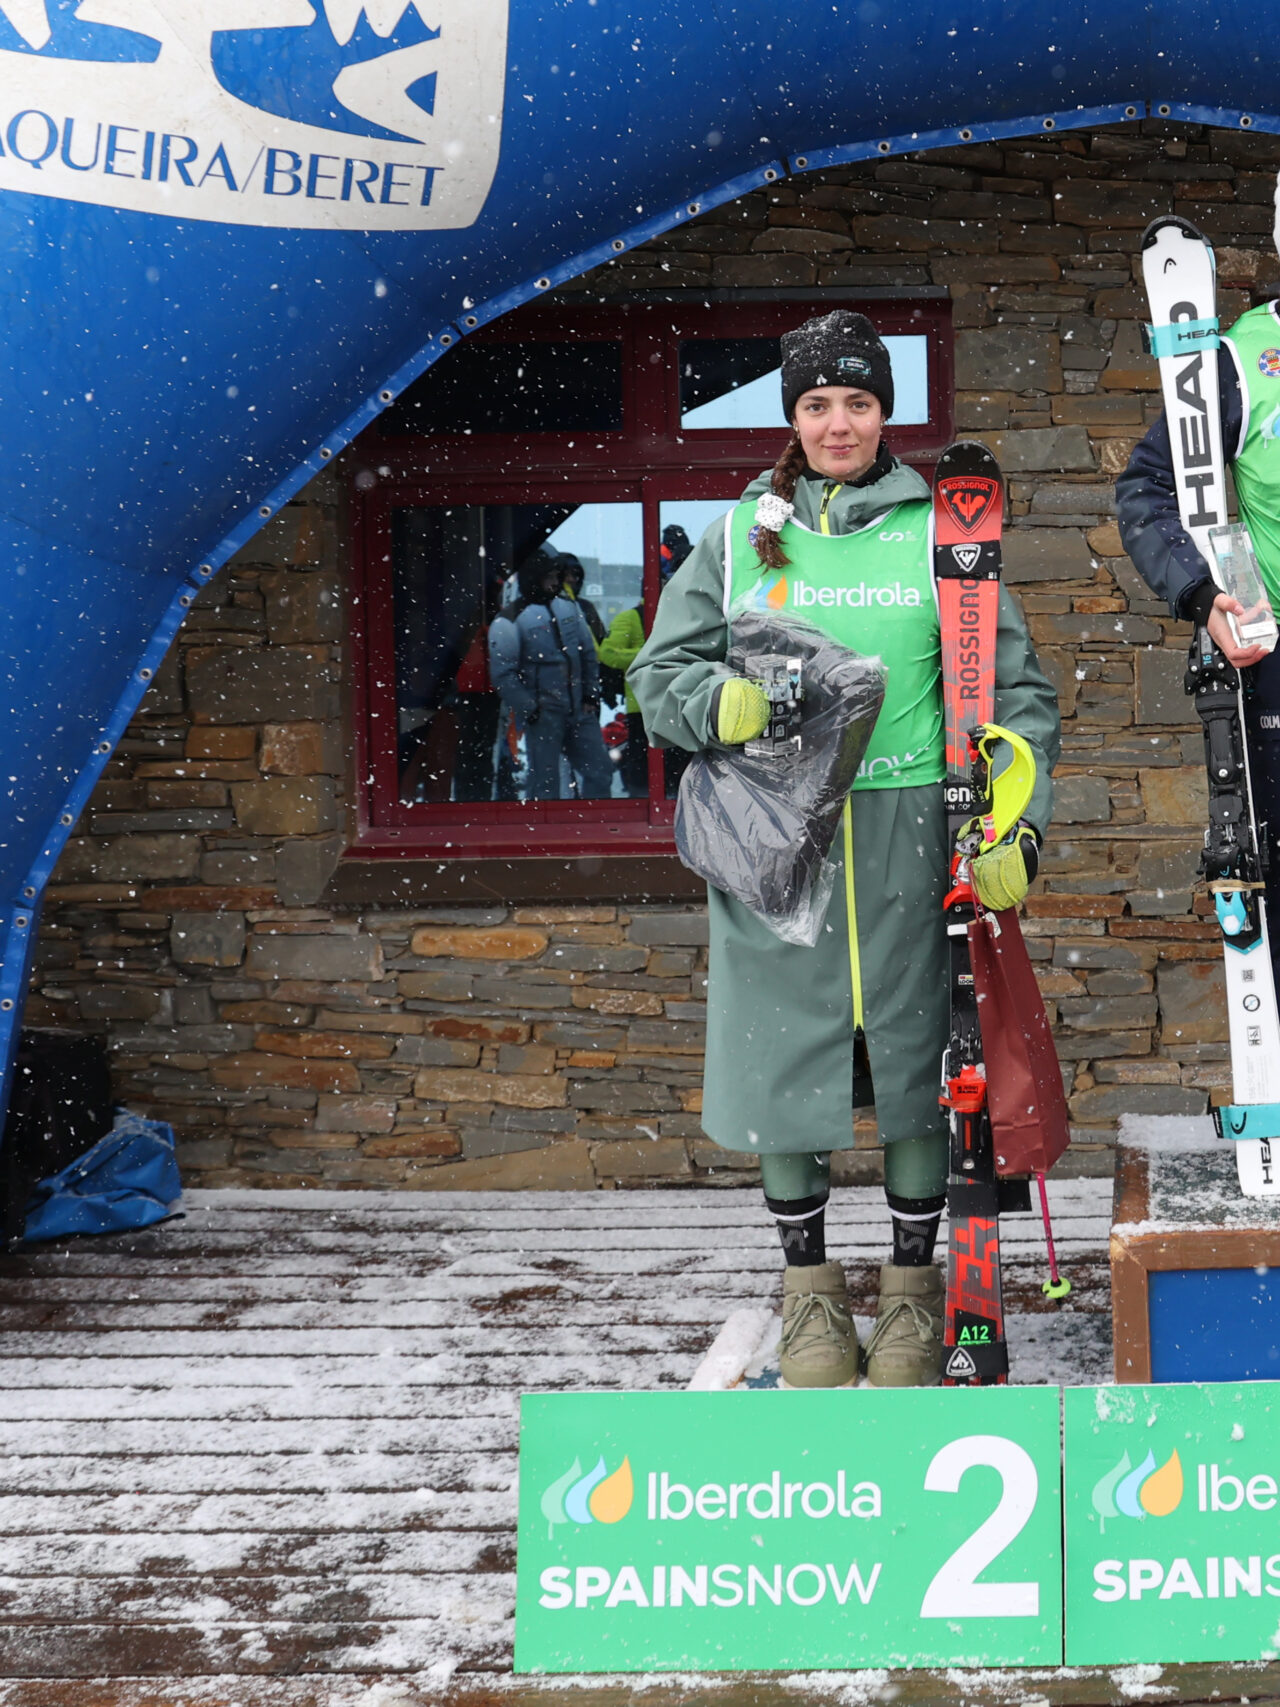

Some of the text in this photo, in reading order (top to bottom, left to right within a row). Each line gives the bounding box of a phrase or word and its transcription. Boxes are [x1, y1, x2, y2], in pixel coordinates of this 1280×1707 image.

[0, 109, 445, 206] QUEIRA/BERET
[1177, 327, 1220, 341] HEA
[793, 581, 921, 607] Iberdrola
[960, 579, 980, 700] ROSSIGNO
[960, 1326, 989, 1340] A12
[648, 1435, 1039, 1618] Iberdrola 2
[538, 1563, 882, 1609] SPAINSNOW
